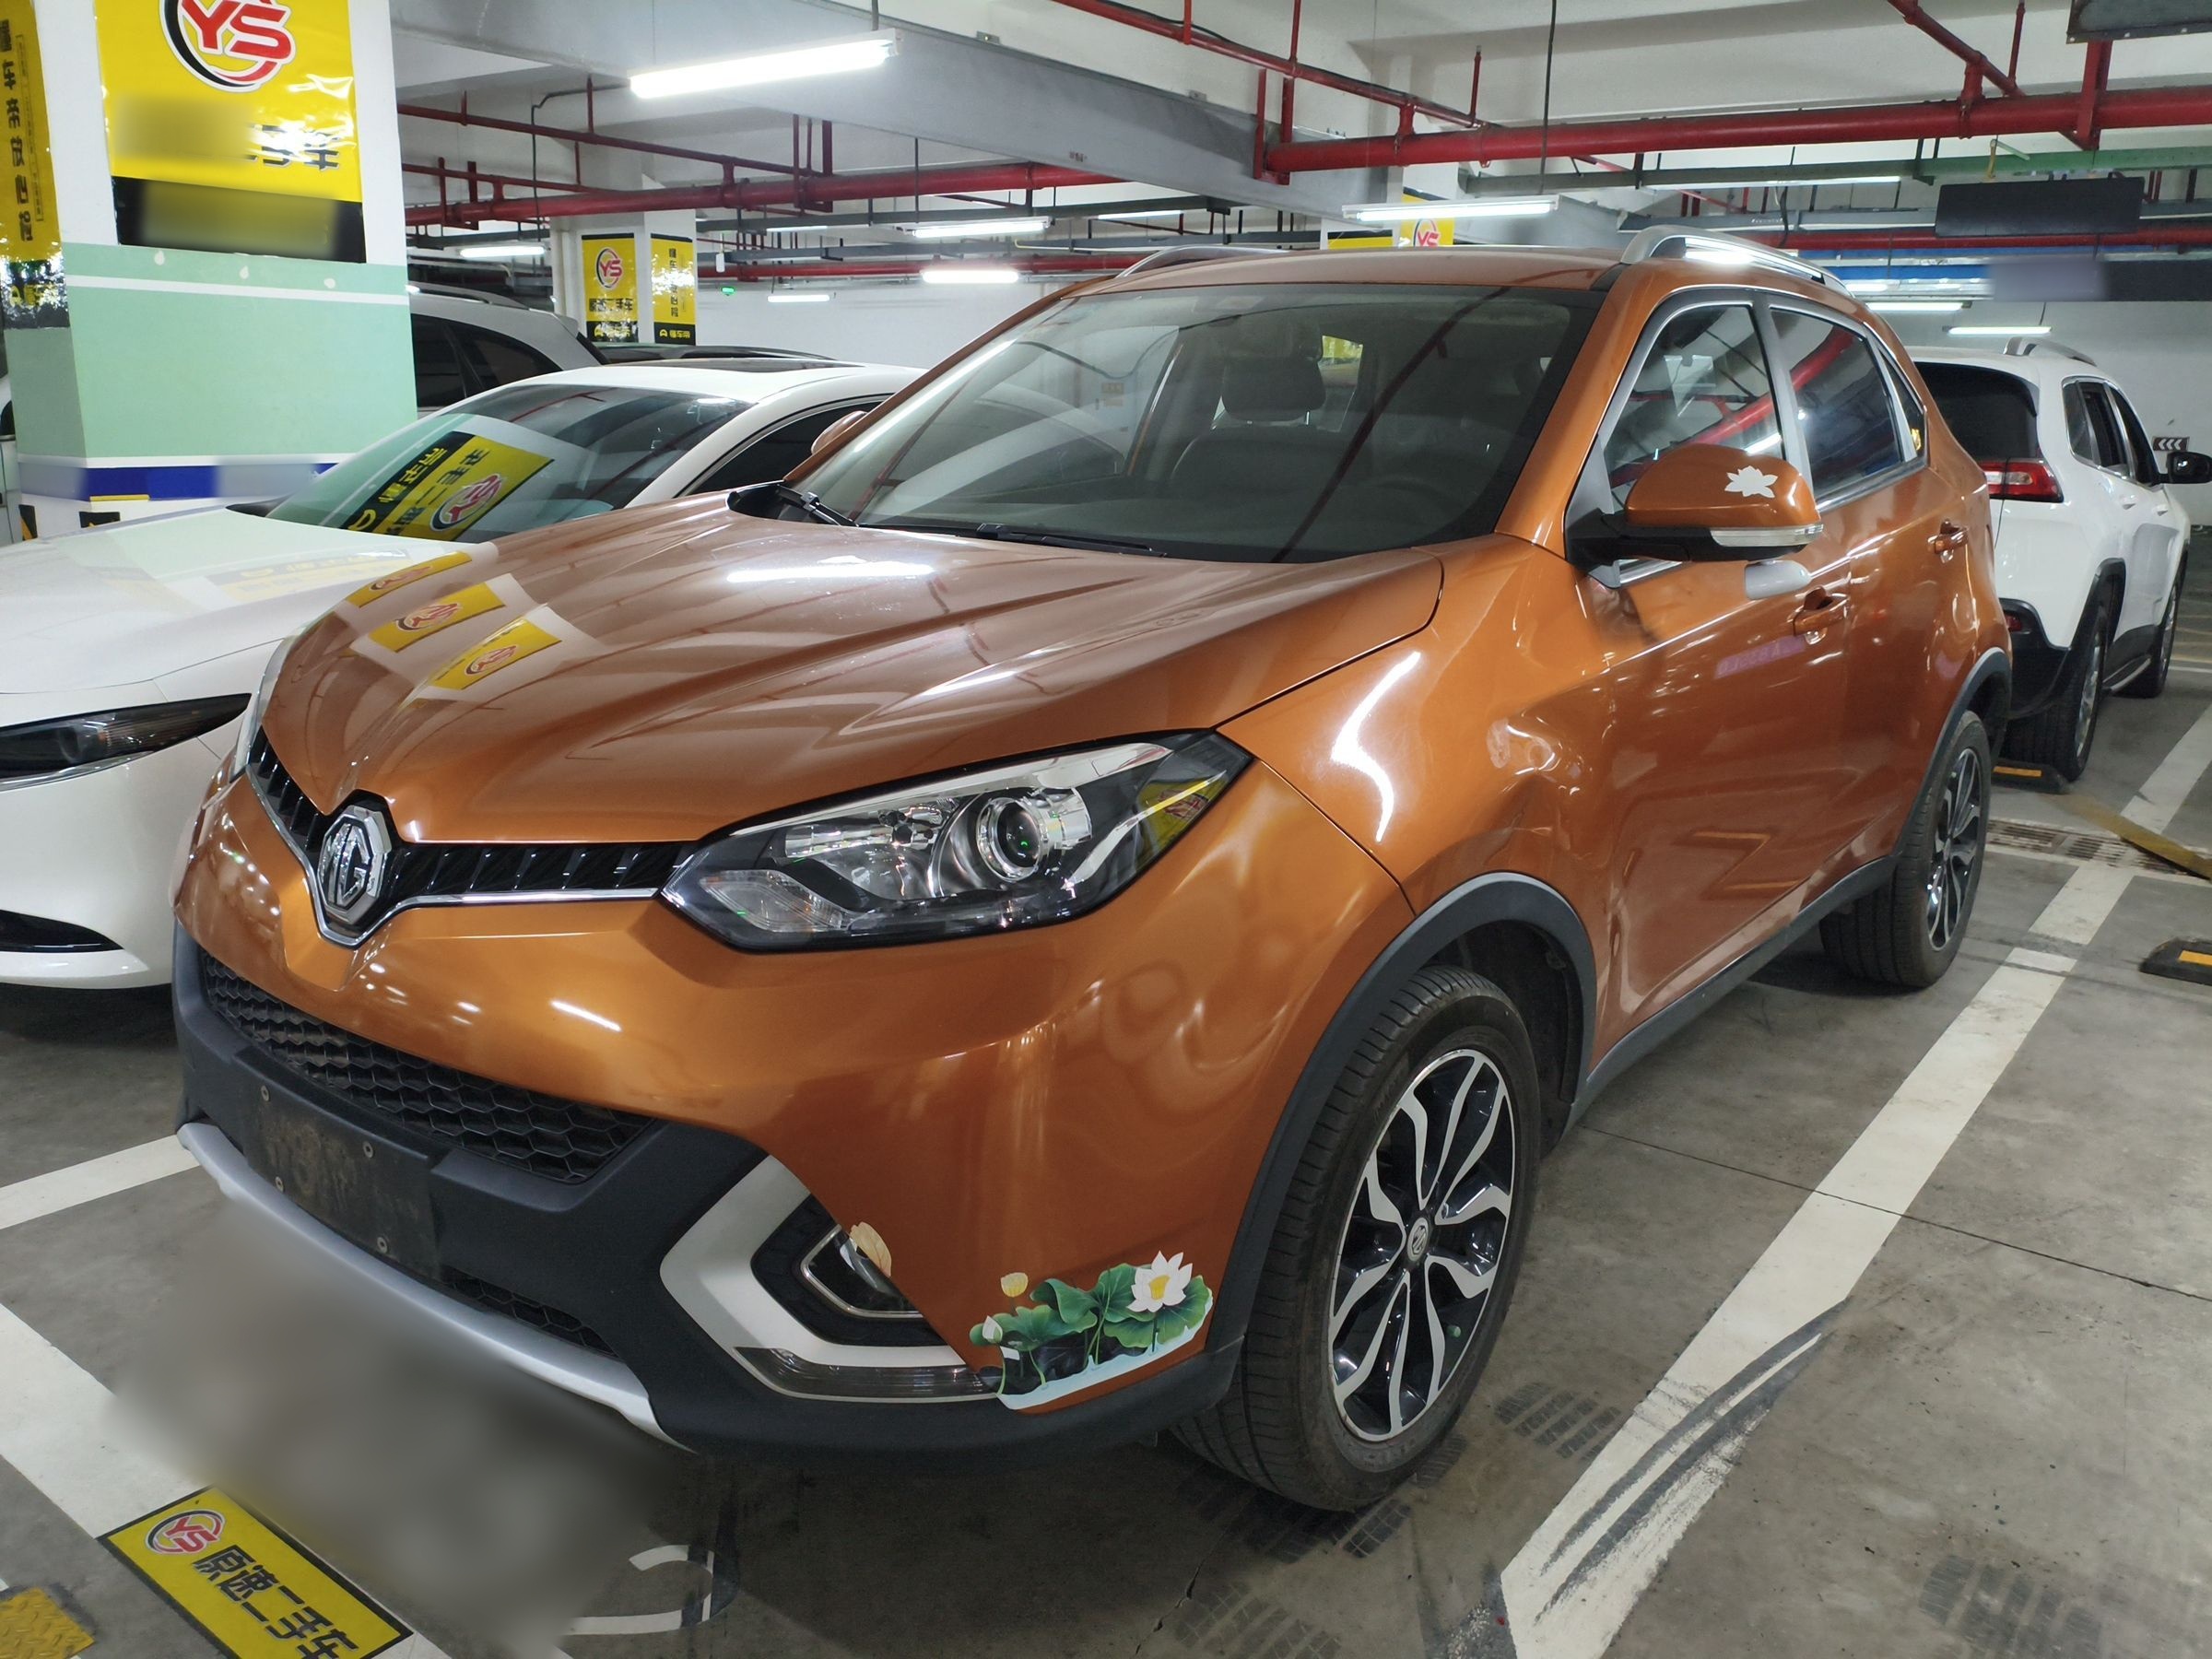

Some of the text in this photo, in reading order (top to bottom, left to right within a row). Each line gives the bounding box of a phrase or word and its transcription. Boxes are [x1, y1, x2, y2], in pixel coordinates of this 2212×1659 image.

[180, 0, 292, 60] YS
[599, 259, 623, 277] YS
[320, 822, 371, 908] MG
[164, 1516, 218, 1553] YS
[192, 1544, 359, 1659] 原速二手车
